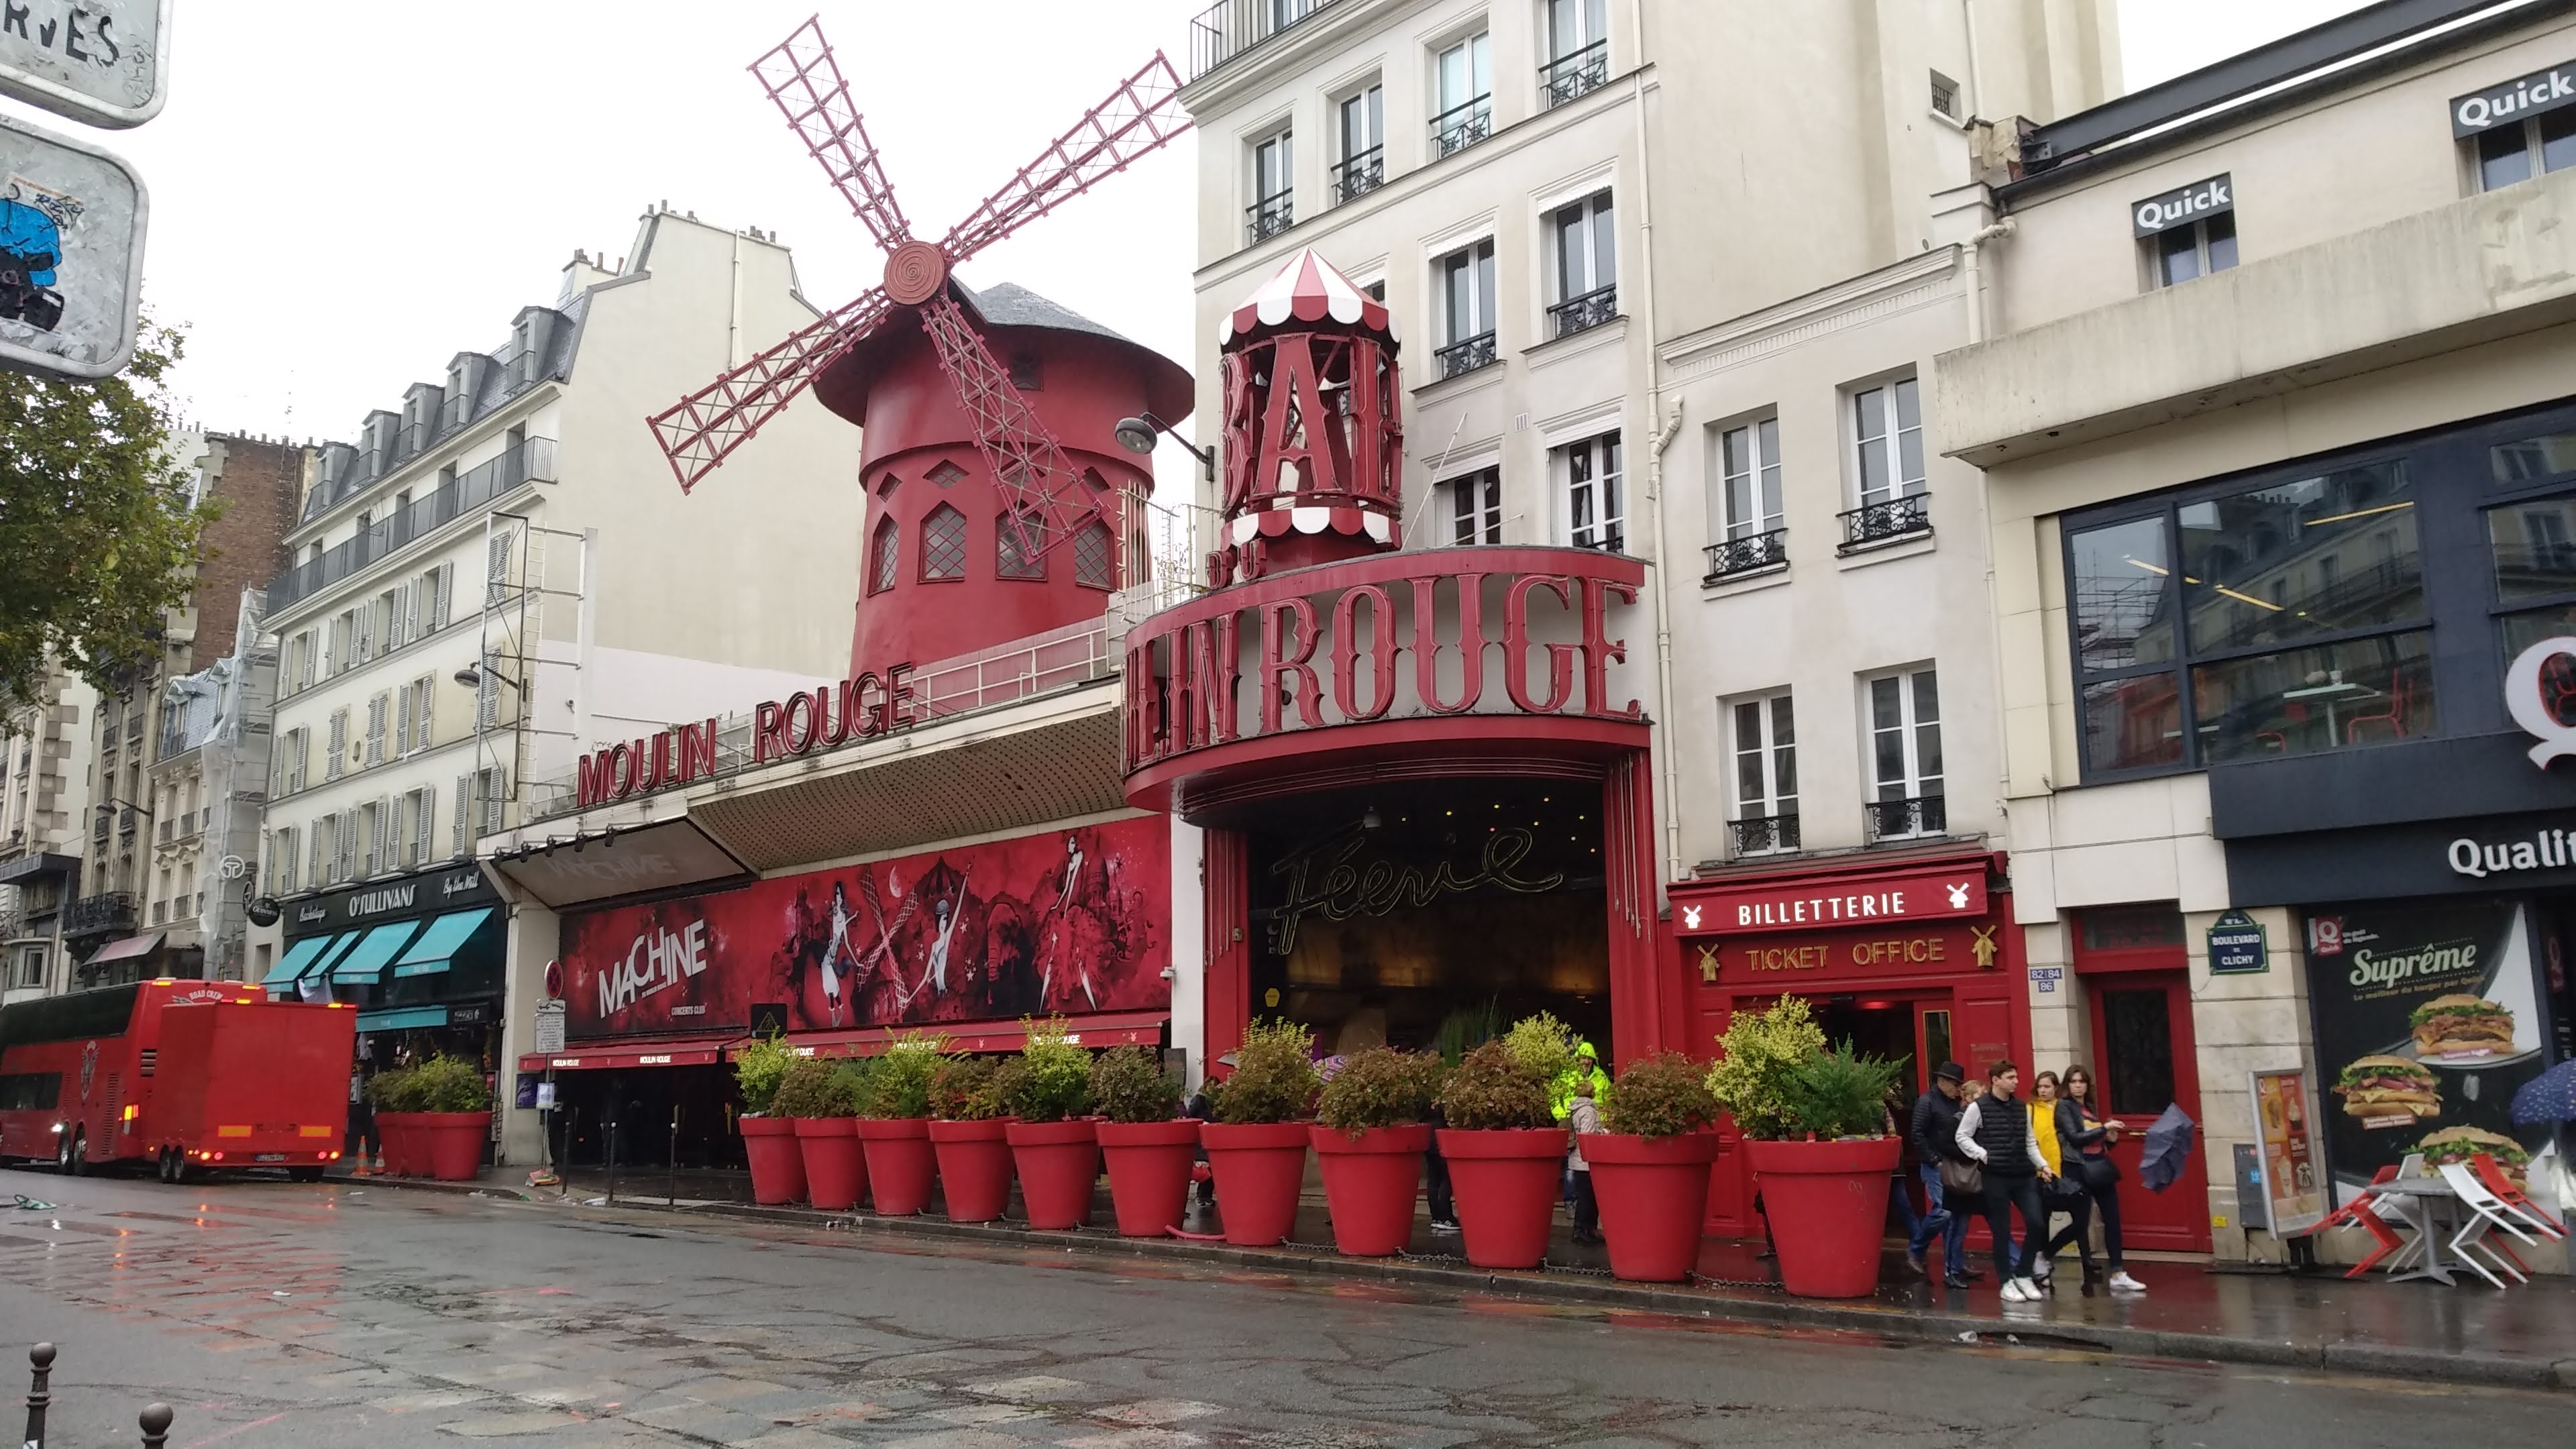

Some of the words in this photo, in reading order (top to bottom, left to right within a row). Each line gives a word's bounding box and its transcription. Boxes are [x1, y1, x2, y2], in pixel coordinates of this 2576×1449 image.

[2458, 70, 2575, 127] Quick
[2137, 180, 2231, 229] Quick
[1258, 572, 1642, 733] ROUGE
[577, 718, 716, 808] MOULIN
[755, 661, 917, 764] ROUGE
[349, 884, 416, 918] O'SULLIVANS
[443, 877, 453, 900] By
[299, 906, 327, 924] Backstage
[1738, 892, 1905, 926] BILLETTERIE
[1746, 945, 1829, 971] TICKET
[1852, 938, 1944, 966] OFFICE
[2212, 934, 2260, 946] BOULEVARD
[598, 918, 707, 1019] MACHINE
[2031, 970, 2045, 979] 82
[2047, 969, 2060, 979] 84
[2222, 955, 2254, 965] CLICHY
[2350, 943, 2477, 989] Suprême
[189, 989, 205, 1000] ROAD
[206, 989, 223, 1000] CREW
[2040, 982, 2053, 991] 86
[639, 1056, 656, 1064] MOULIN
[656, 1055, 672, 1063] ROUGE
